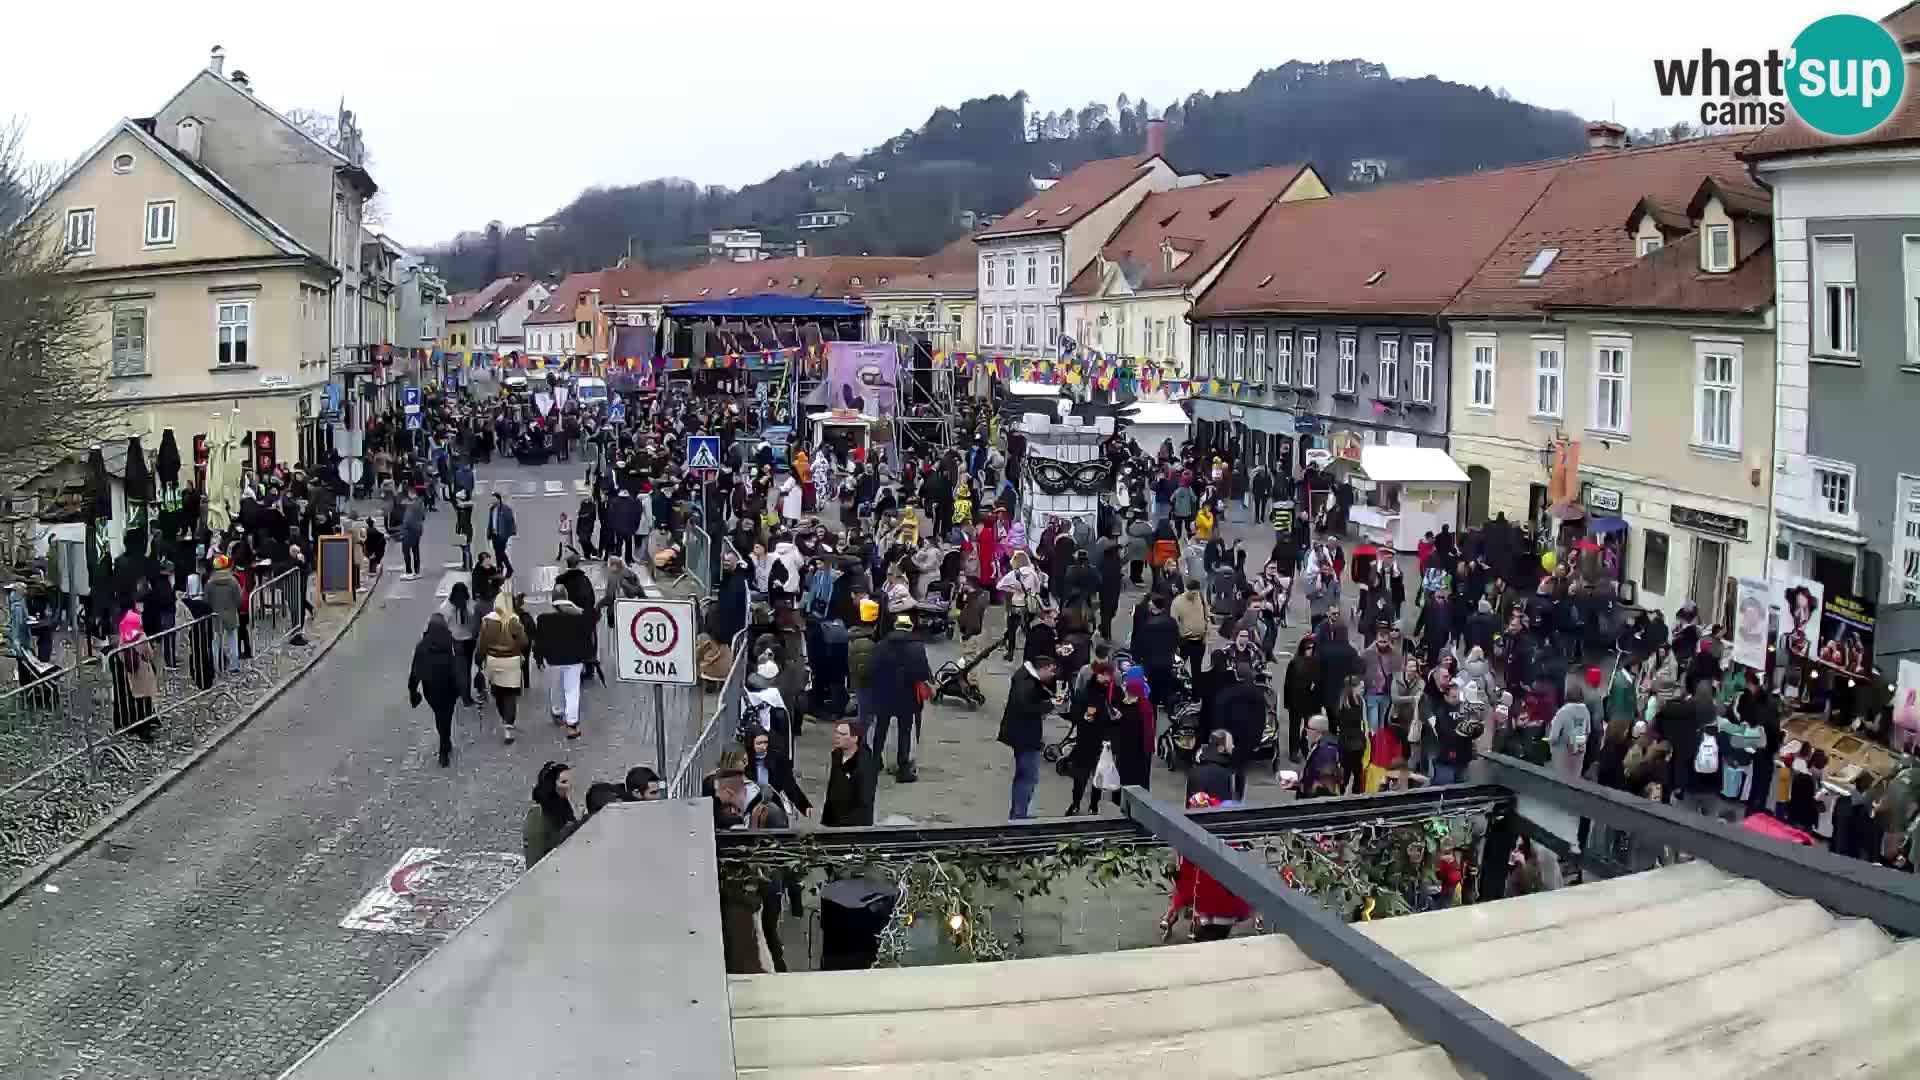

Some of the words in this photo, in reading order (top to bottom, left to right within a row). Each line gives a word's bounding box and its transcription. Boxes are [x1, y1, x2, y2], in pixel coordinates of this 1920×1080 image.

[407, 391, 416, 403] P
[643, 622, 667, 643] 30
[633, 659, 678, 676] ZONA
